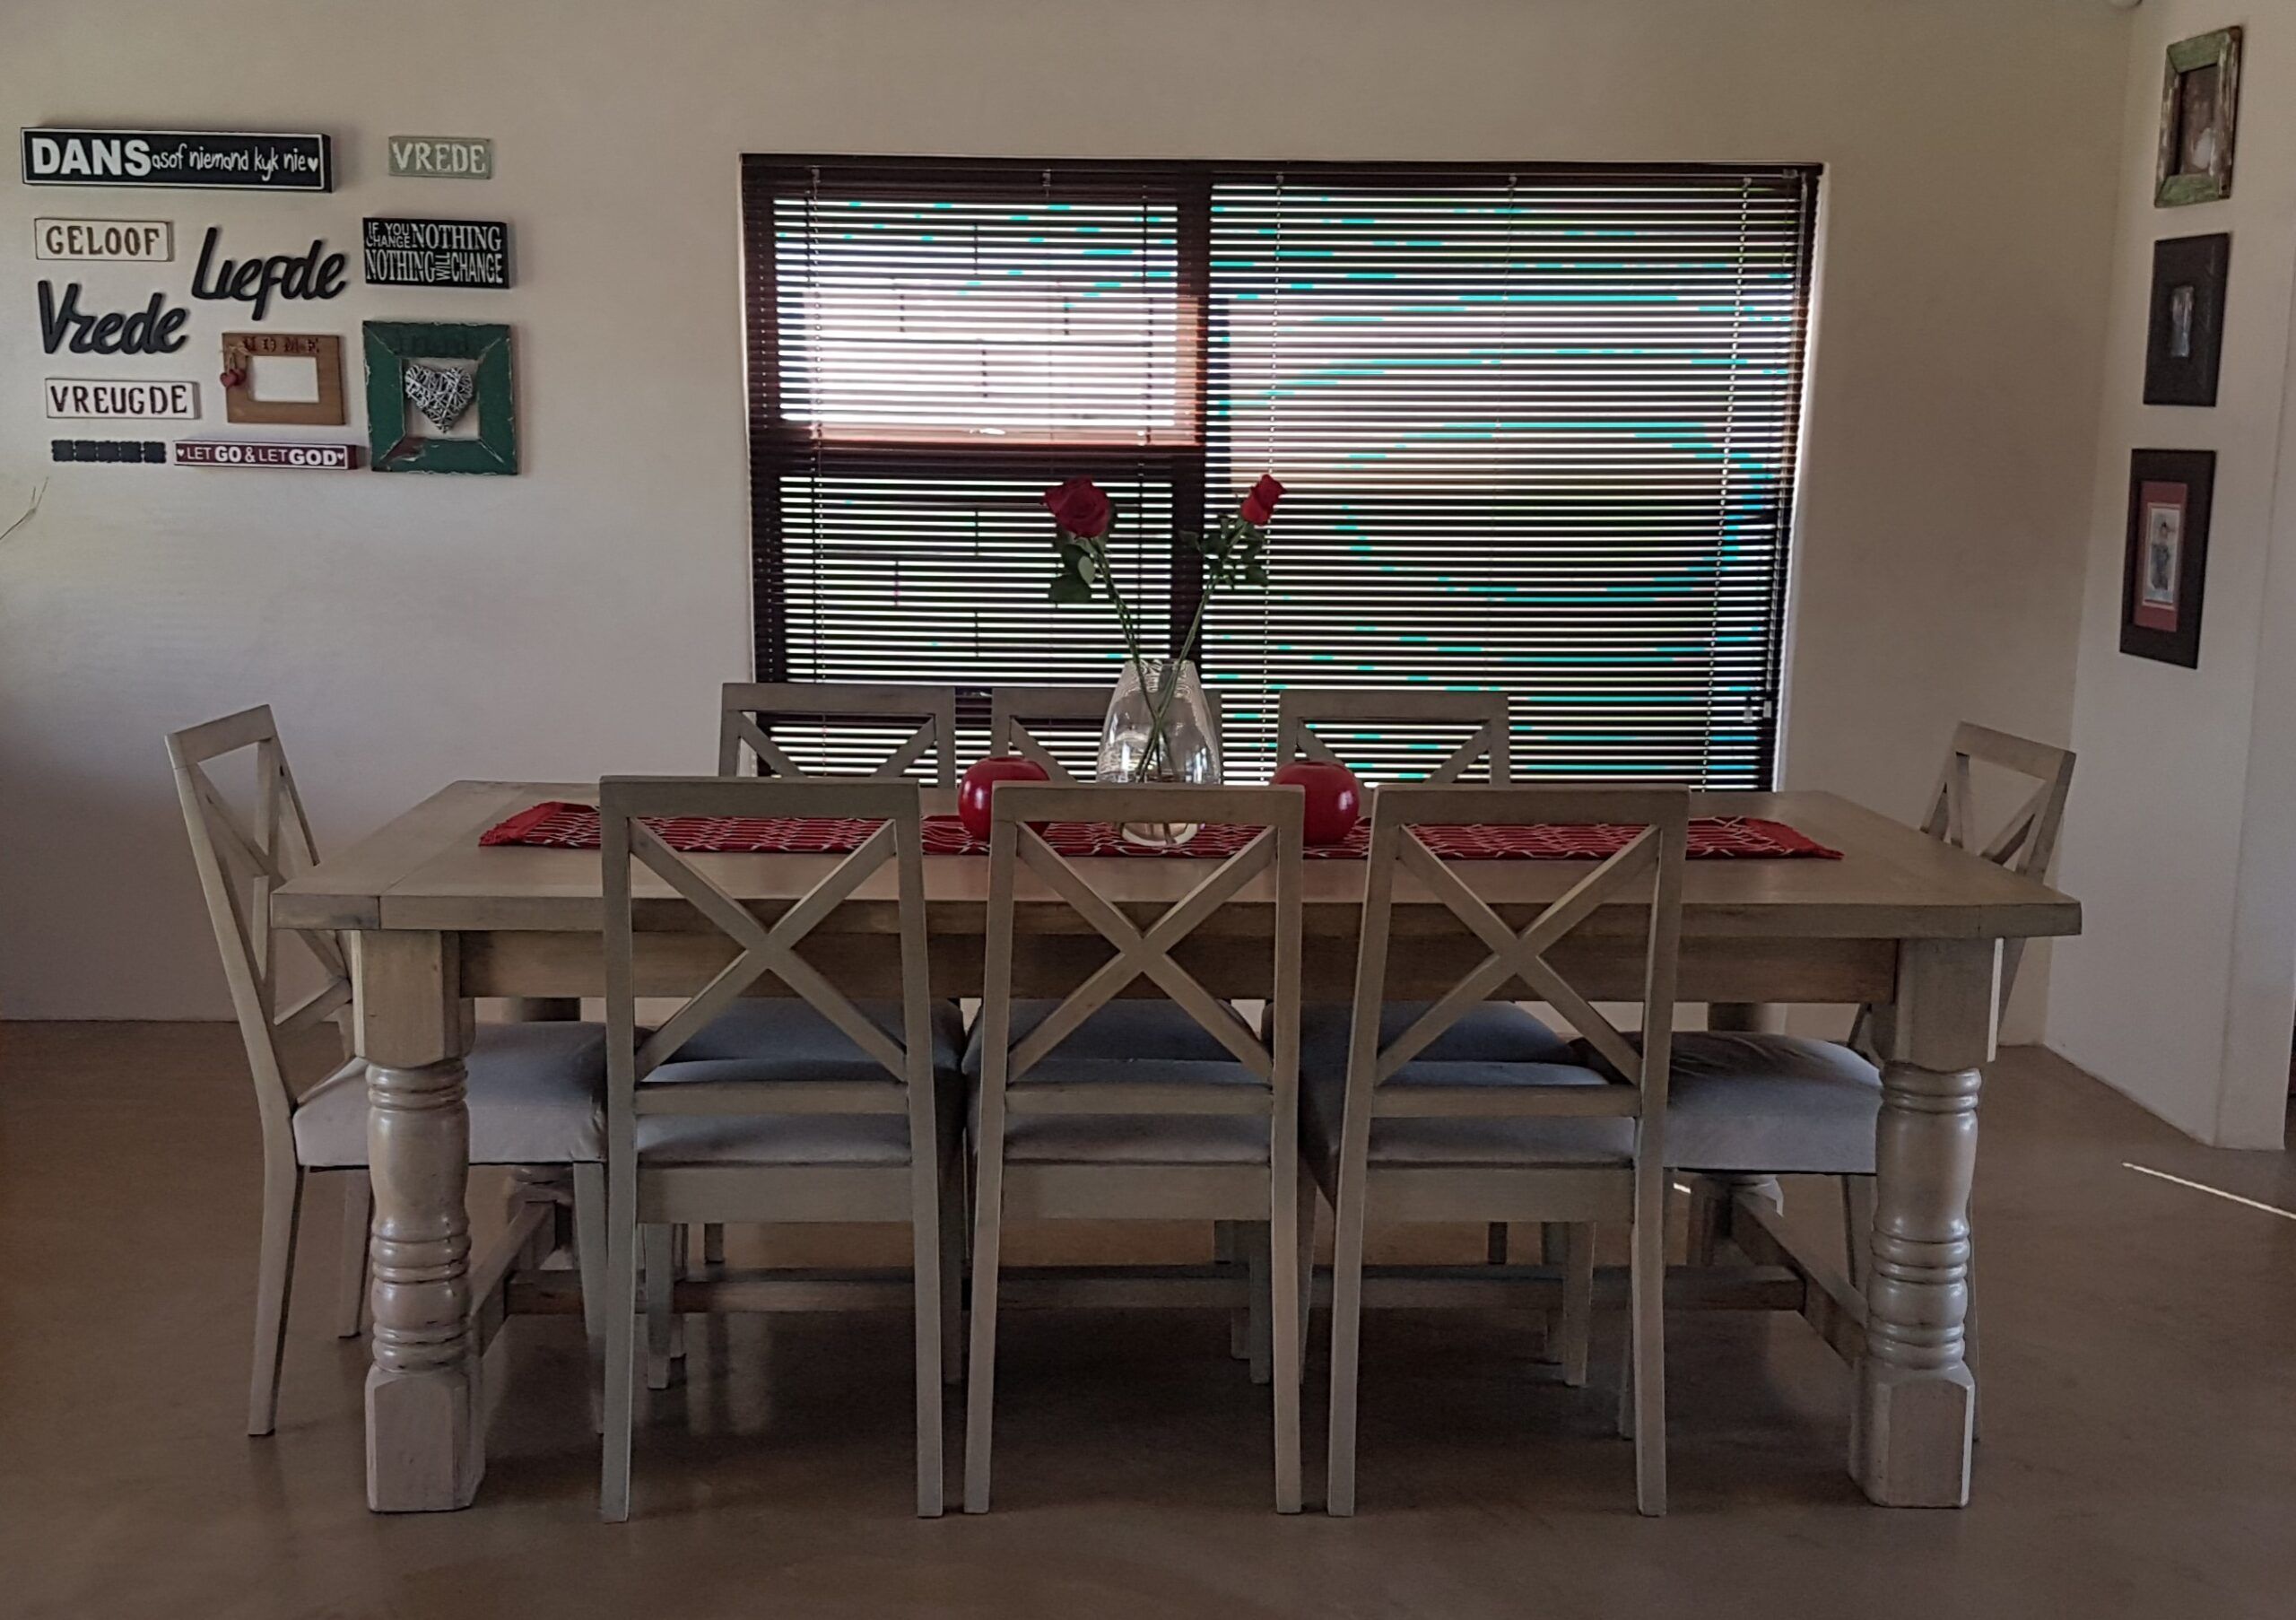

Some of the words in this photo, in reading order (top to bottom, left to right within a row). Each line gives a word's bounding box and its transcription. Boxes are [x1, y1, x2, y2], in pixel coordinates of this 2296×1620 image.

[31, 137, 152, 177] DANS
[152, 143, 187, 171] asof
[190, 146, 248, 172] niemand
[254, 146, 278, 181] kyk
[283, 148, 307, 172] nie
[392, 142, 485, 173] VREDE
[46, 225, 161, 256] GELOOF
[366, 235, 411, 248] CHANGE
[411, 223, 502, 251] NOTHING
[369, 222, 379, 238] IF
[384, 222, 410, 236] YOU
[191, 227, 347, 321] Liefde
[365, 248, 435, 283] NOTHING
[435, 252, 451, 281] WILL
[451, 252, 503, 283] CHANGE
[38, 280, 190, 354] Vrede
[50, 385, 187, 414] VREUGDE
[187, 447, 211, 460] LET
[214, 448, 242, 463] GO
[245, 448, 255, 463] &
[258, 450, 288, 464] LET
[288, 450, 337, 466] GOD
